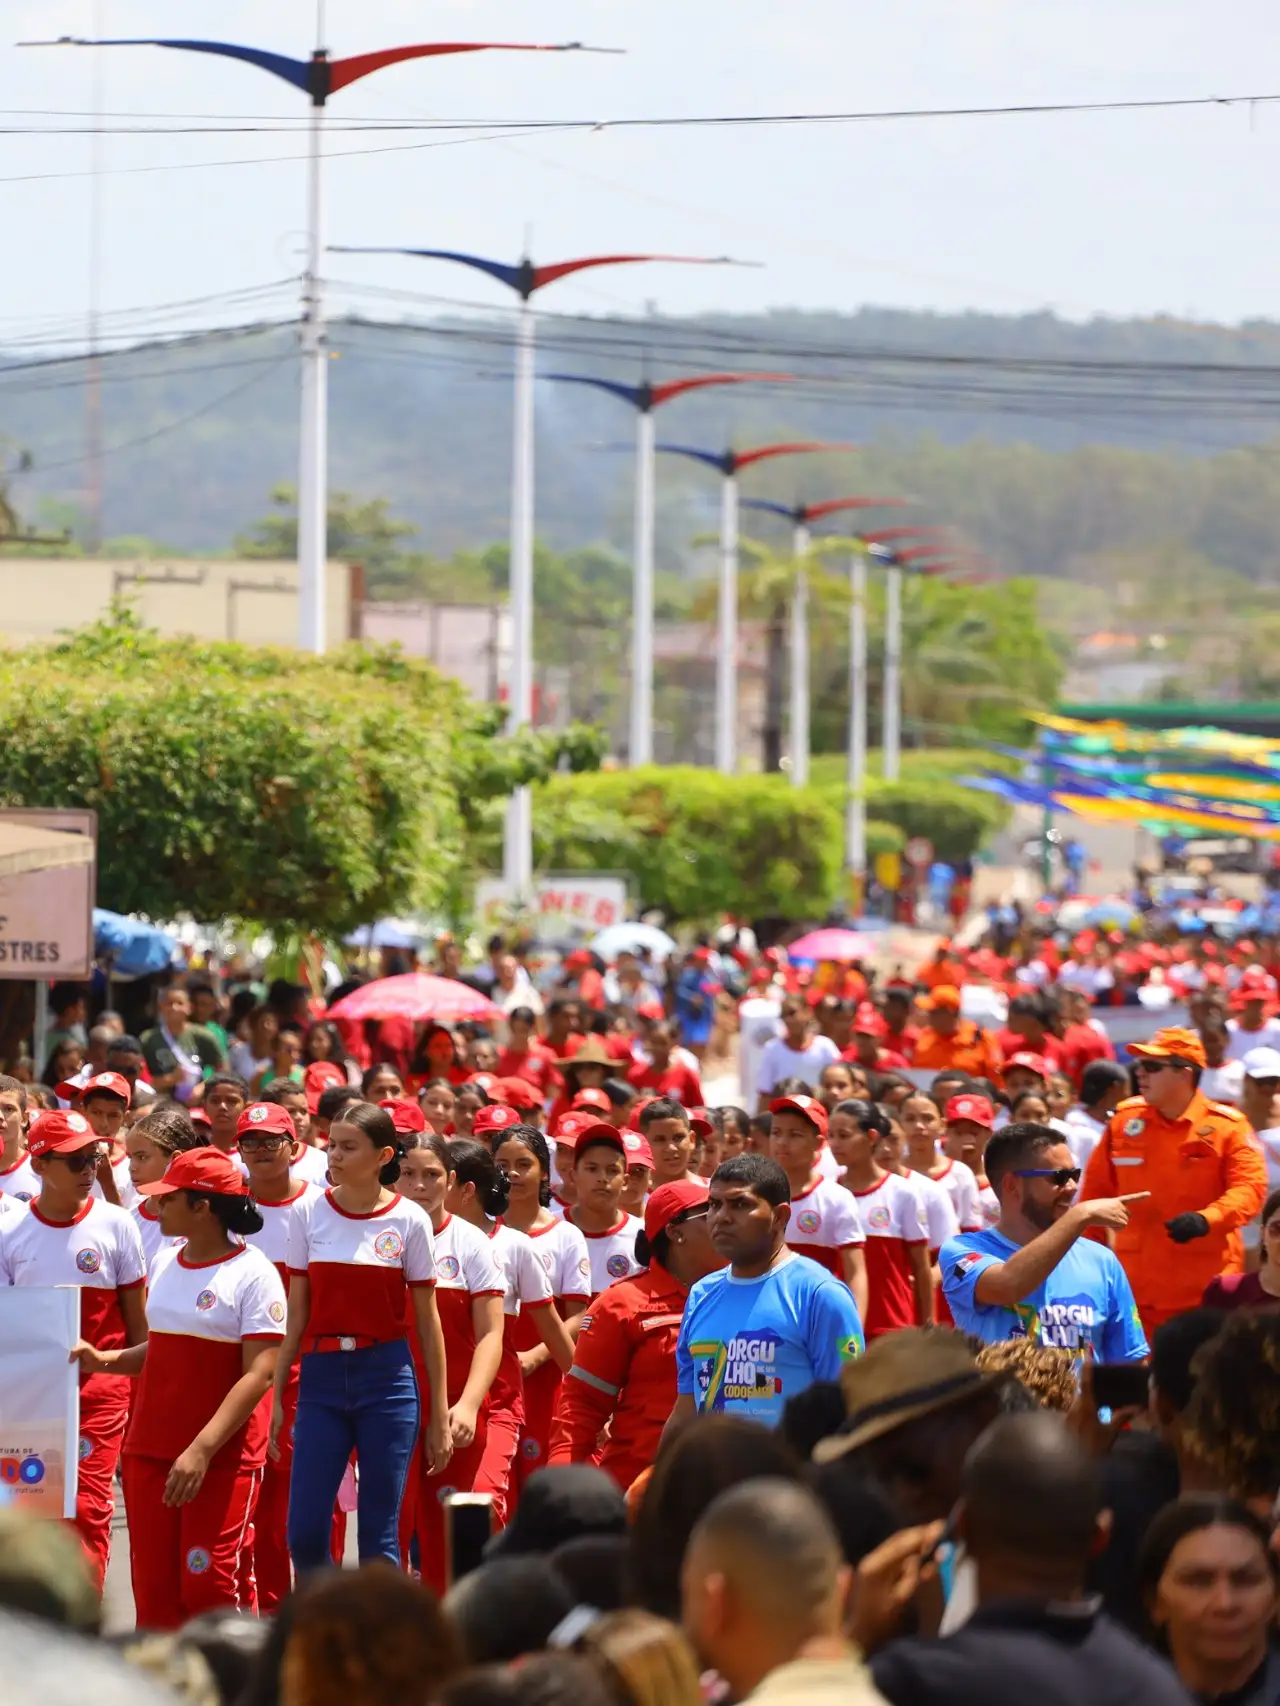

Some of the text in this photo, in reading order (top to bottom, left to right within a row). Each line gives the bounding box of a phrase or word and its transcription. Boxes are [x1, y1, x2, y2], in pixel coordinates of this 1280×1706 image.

[1039, 1303, 1095, 1327] ORGU
[1041, 1325, 1080, 1348] LHO
[727, 1338, 776, 1364] ORGU
[723, 1361, 757, 1385] LHO
